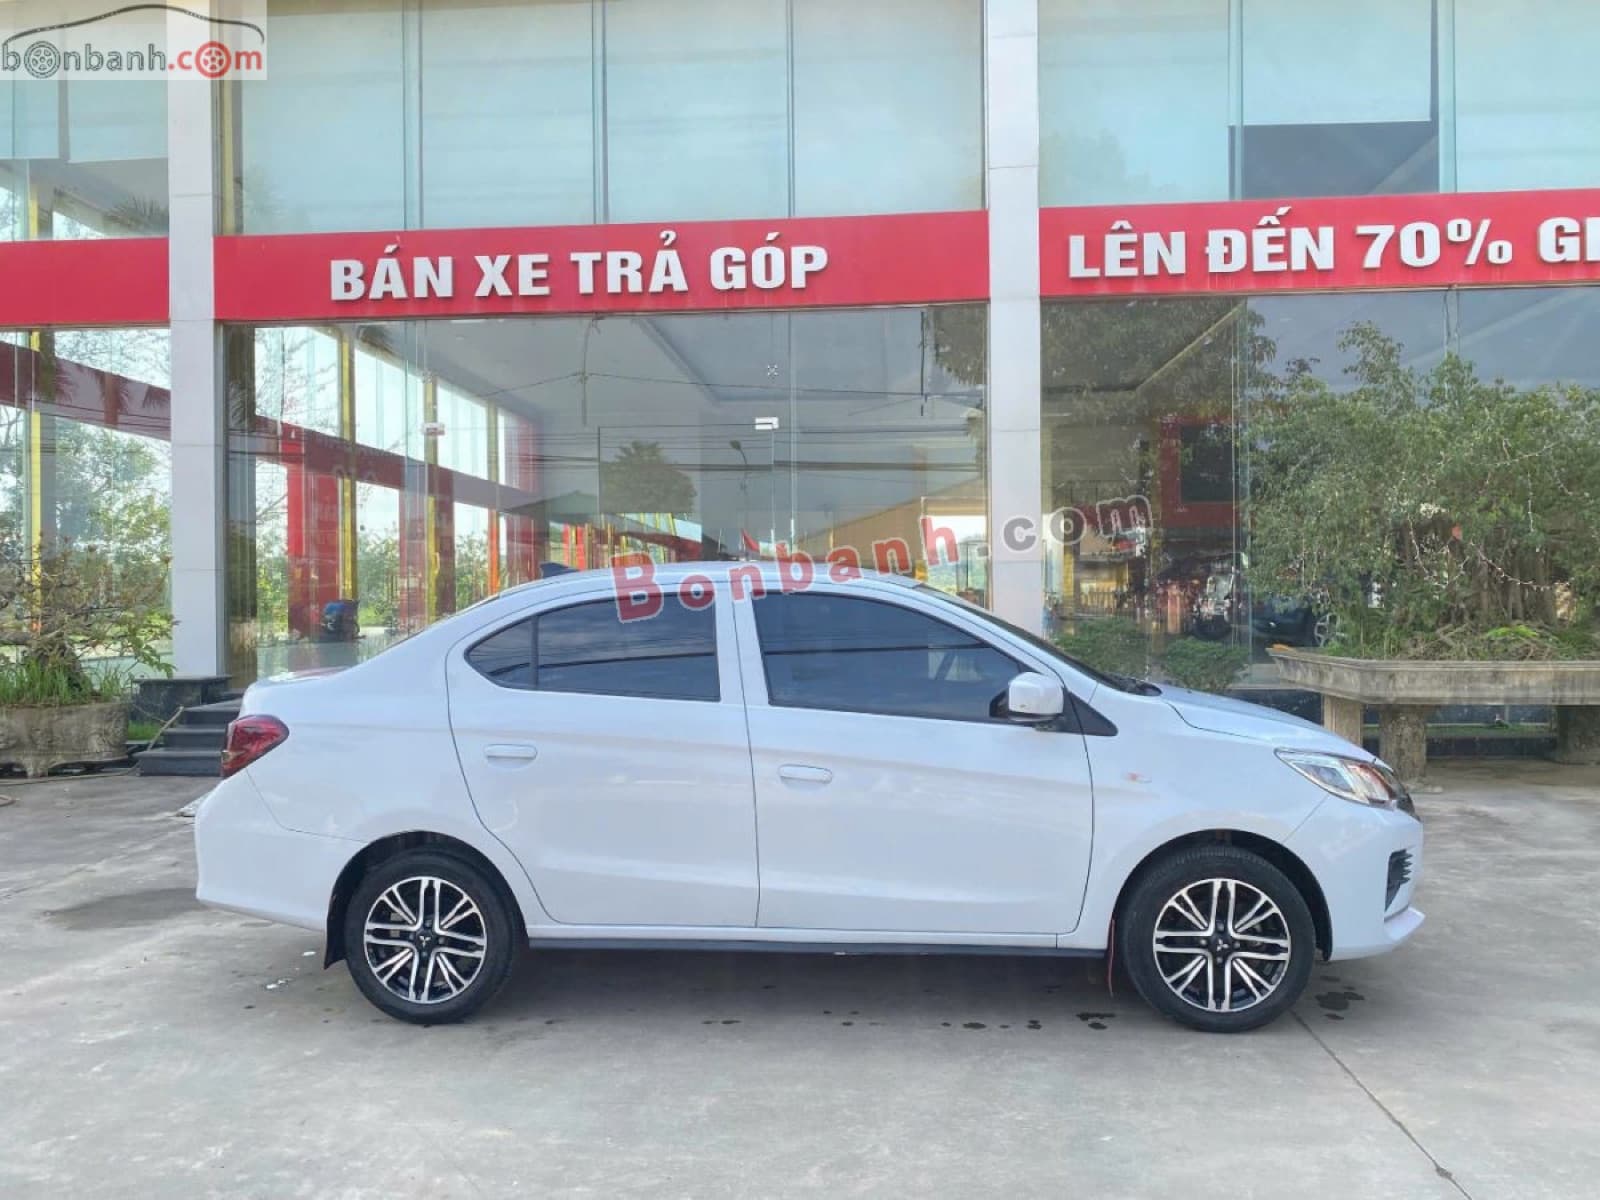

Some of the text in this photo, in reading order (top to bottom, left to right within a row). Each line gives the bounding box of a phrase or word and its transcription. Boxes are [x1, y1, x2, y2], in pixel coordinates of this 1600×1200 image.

[330, 230, 828, 301] BÁN XE TRẢ GÓP
[1068, 220, 1186, 279] LÊN
[1205, 206, 1334, 274] ĐẾN
[1356, 217, 1513, 268] 70%
